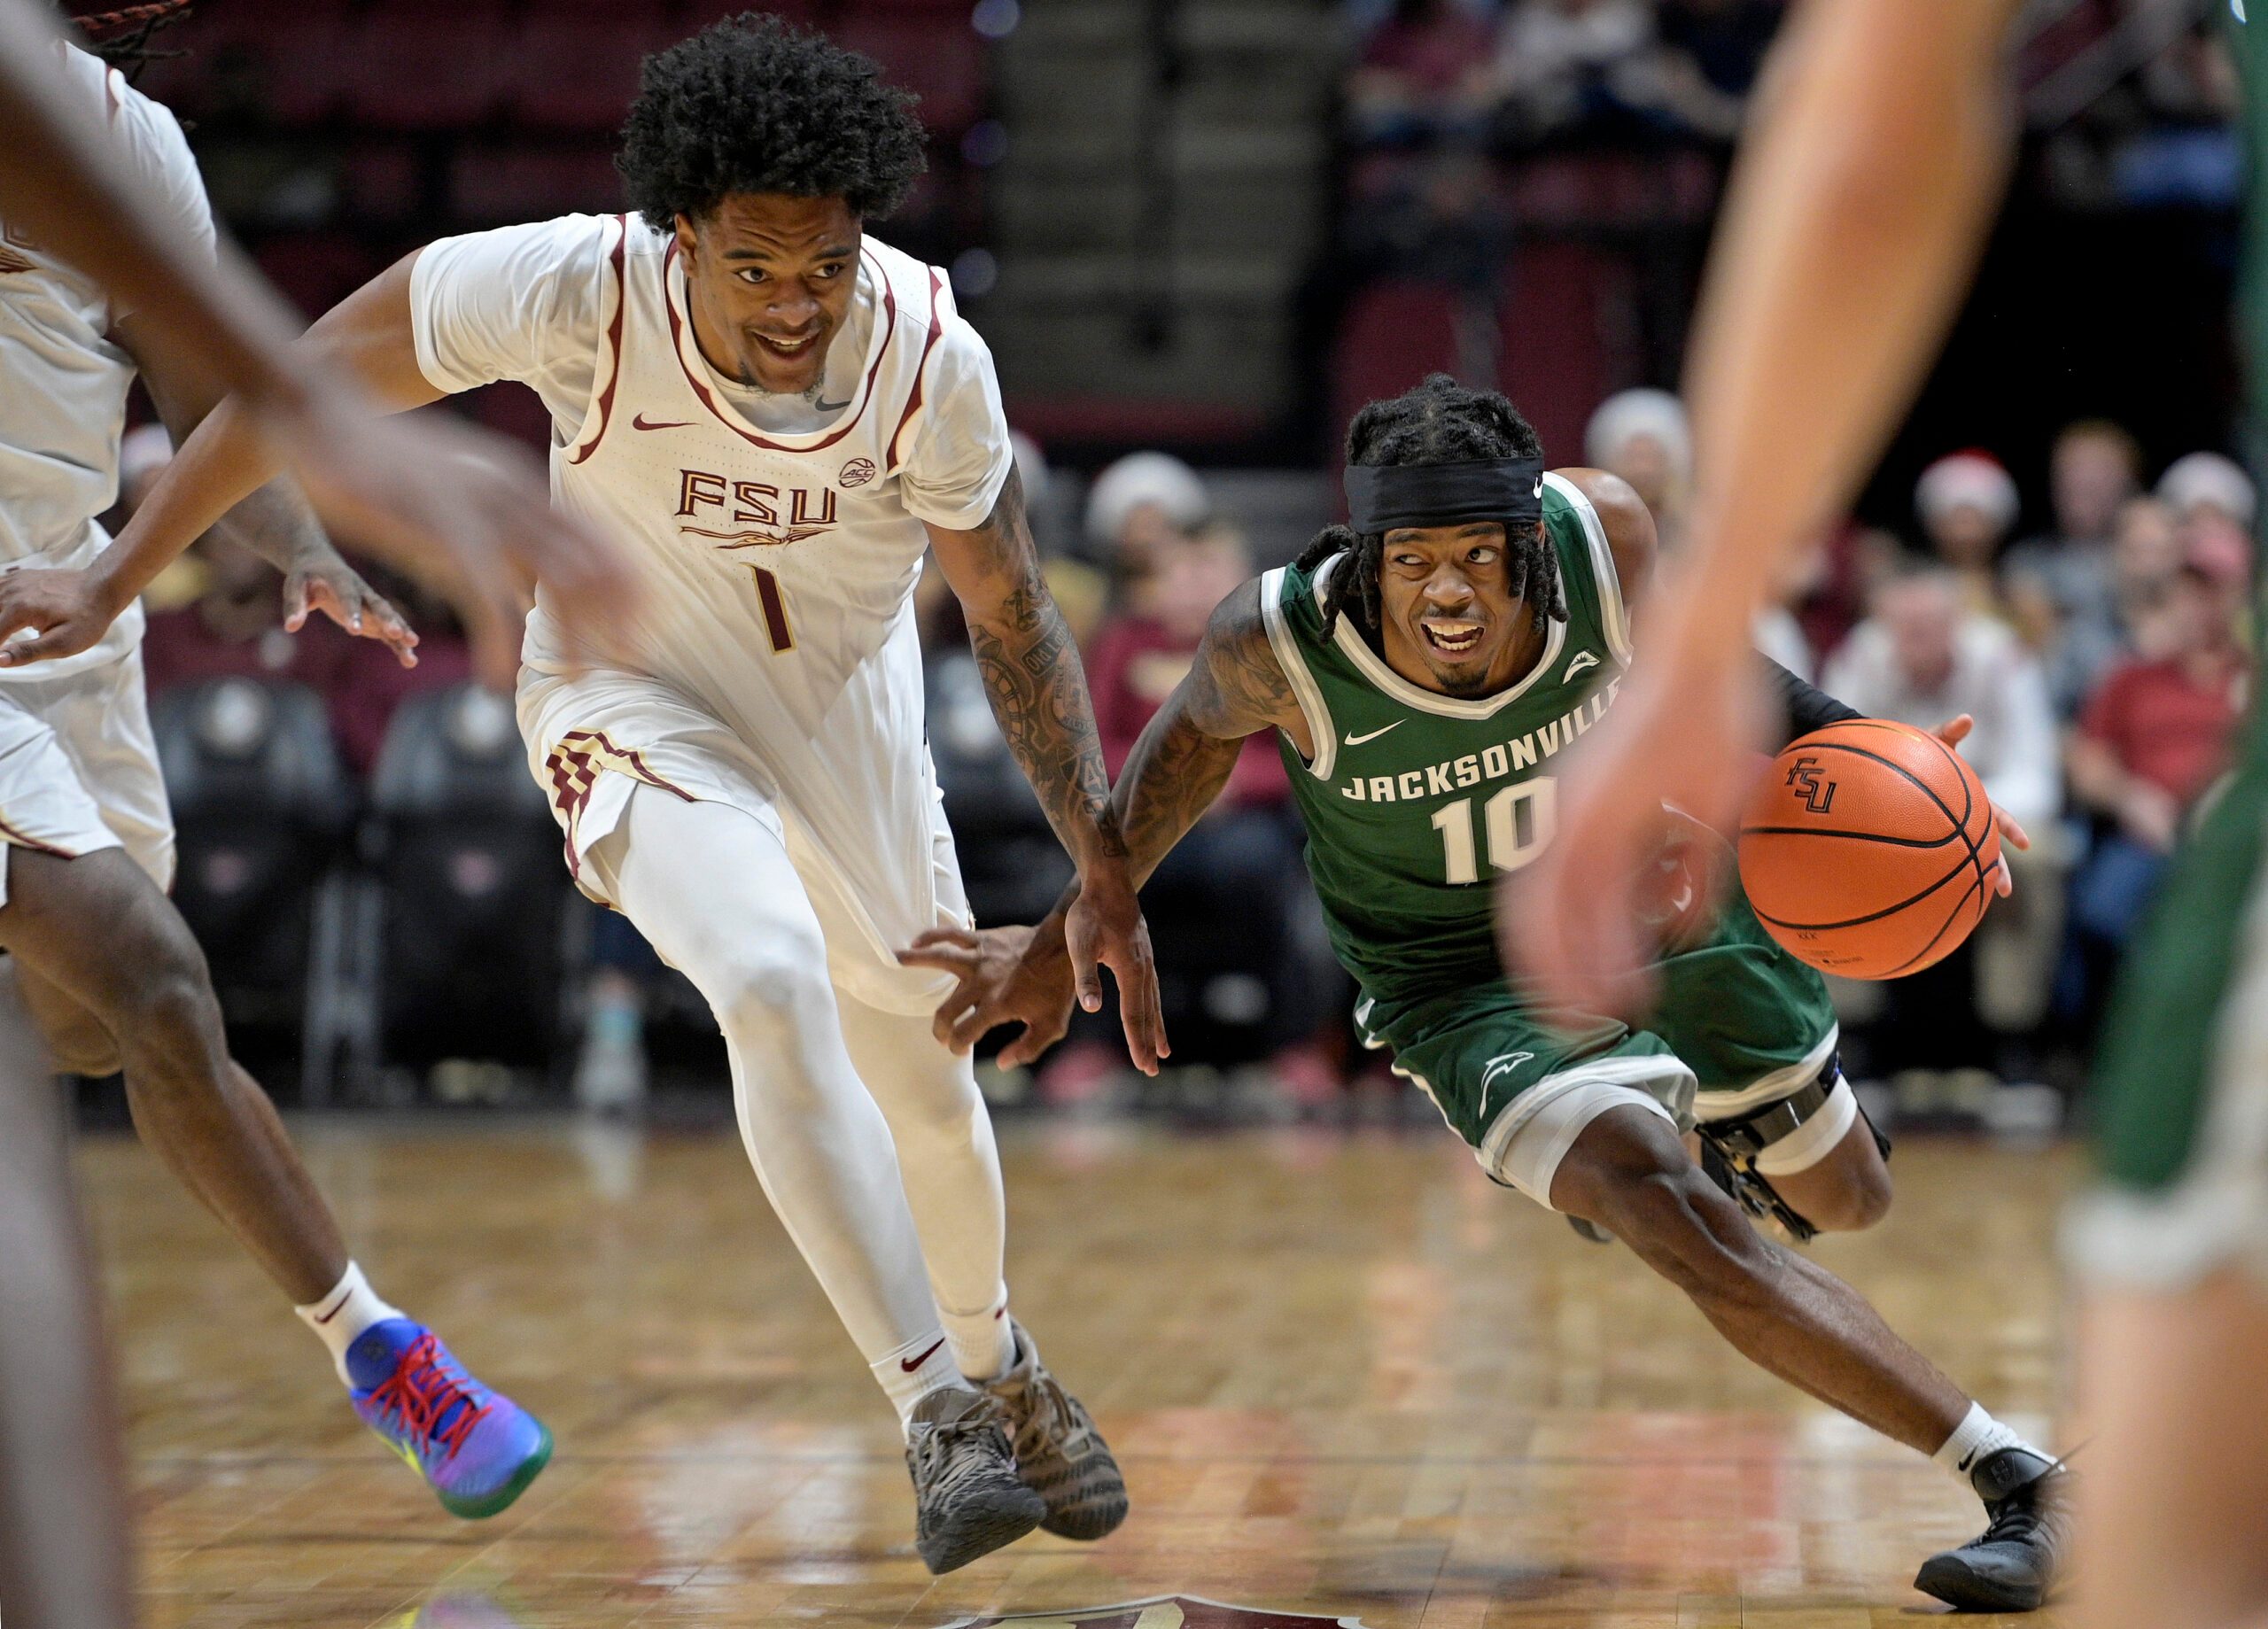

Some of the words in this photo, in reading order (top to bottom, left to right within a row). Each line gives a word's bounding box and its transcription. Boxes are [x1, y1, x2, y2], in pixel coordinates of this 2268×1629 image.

[674, 469, 838, 527] FSU
[740, 562, 796, 655] 1
[1784, 757, 1837, 813] FSU
[1431, 776, 1558, 885] 10
